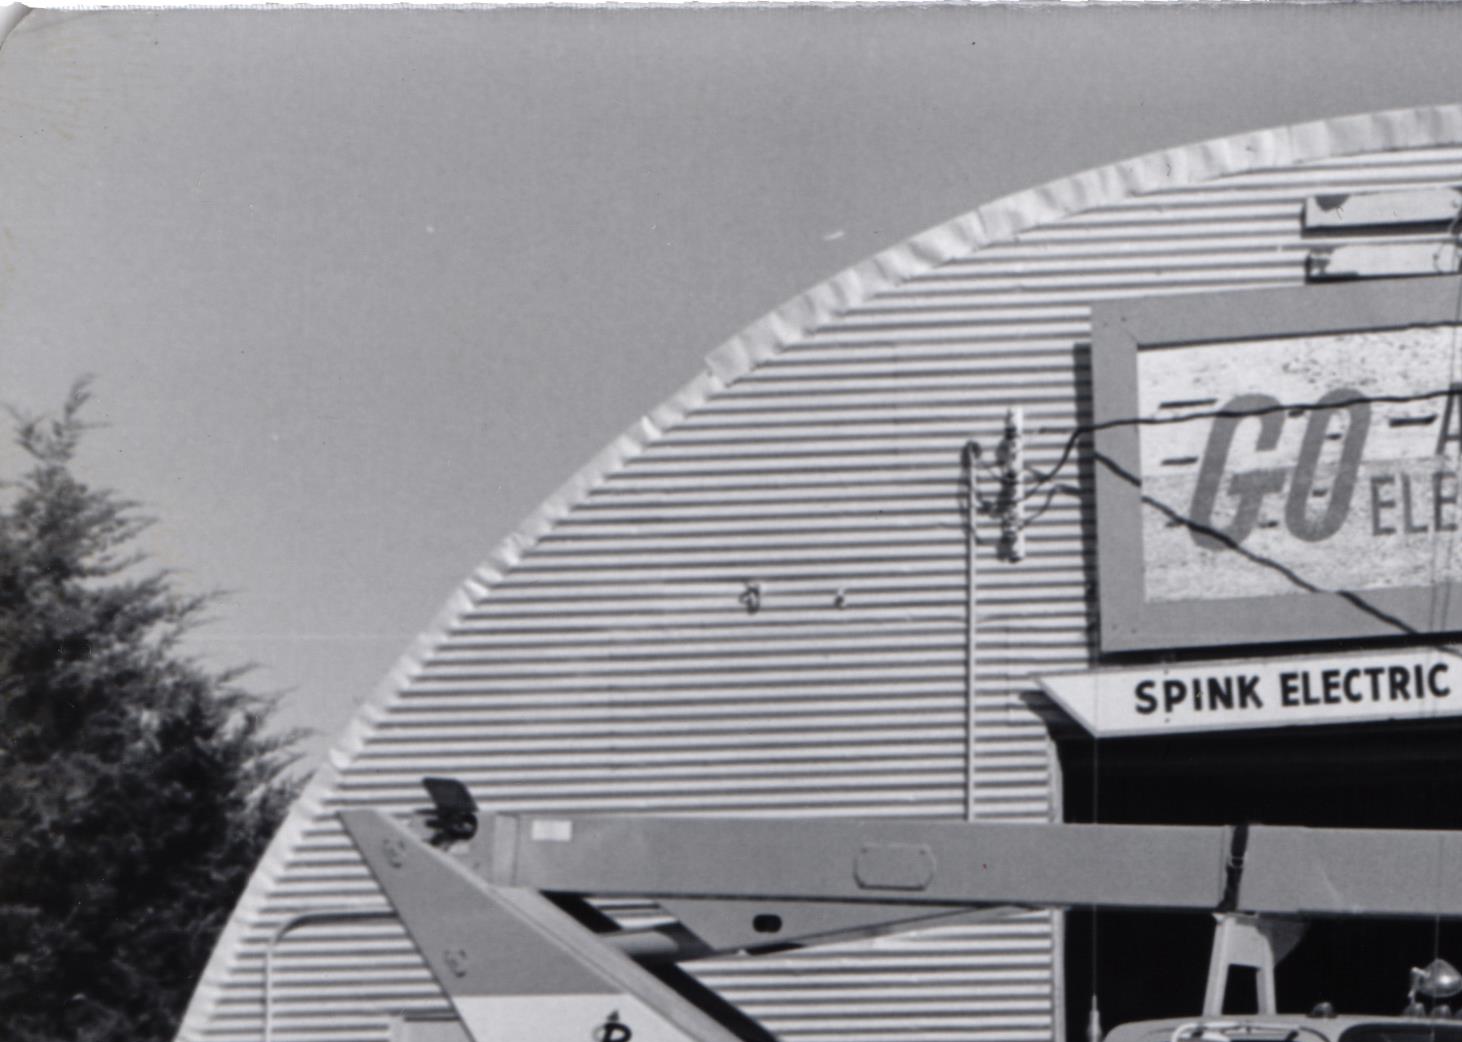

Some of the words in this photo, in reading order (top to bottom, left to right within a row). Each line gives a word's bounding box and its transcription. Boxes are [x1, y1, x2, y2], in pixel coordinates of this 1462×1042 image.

[1188, 387, 1372, 550] GO
[1134, 674, 1264, 715] SPINK
[1279, 662, 1451, 707] ELECTRIC
